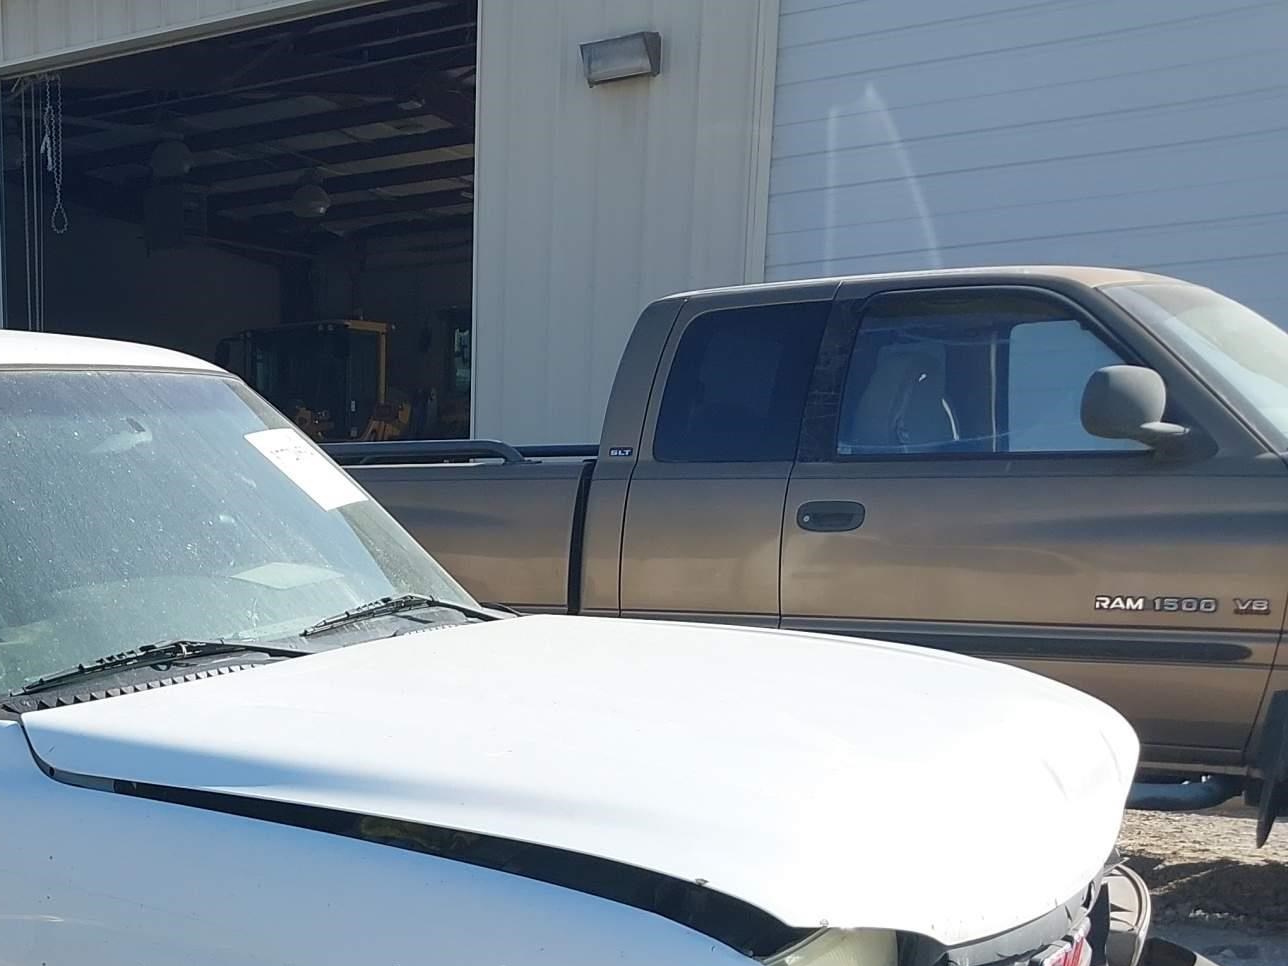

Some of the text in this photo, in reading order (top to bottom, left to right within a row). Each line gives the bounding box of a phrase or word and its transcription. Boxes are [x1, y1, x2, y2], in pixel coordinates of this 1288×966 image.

[1095, 595, 1270, 612] RAM 1500 V8
